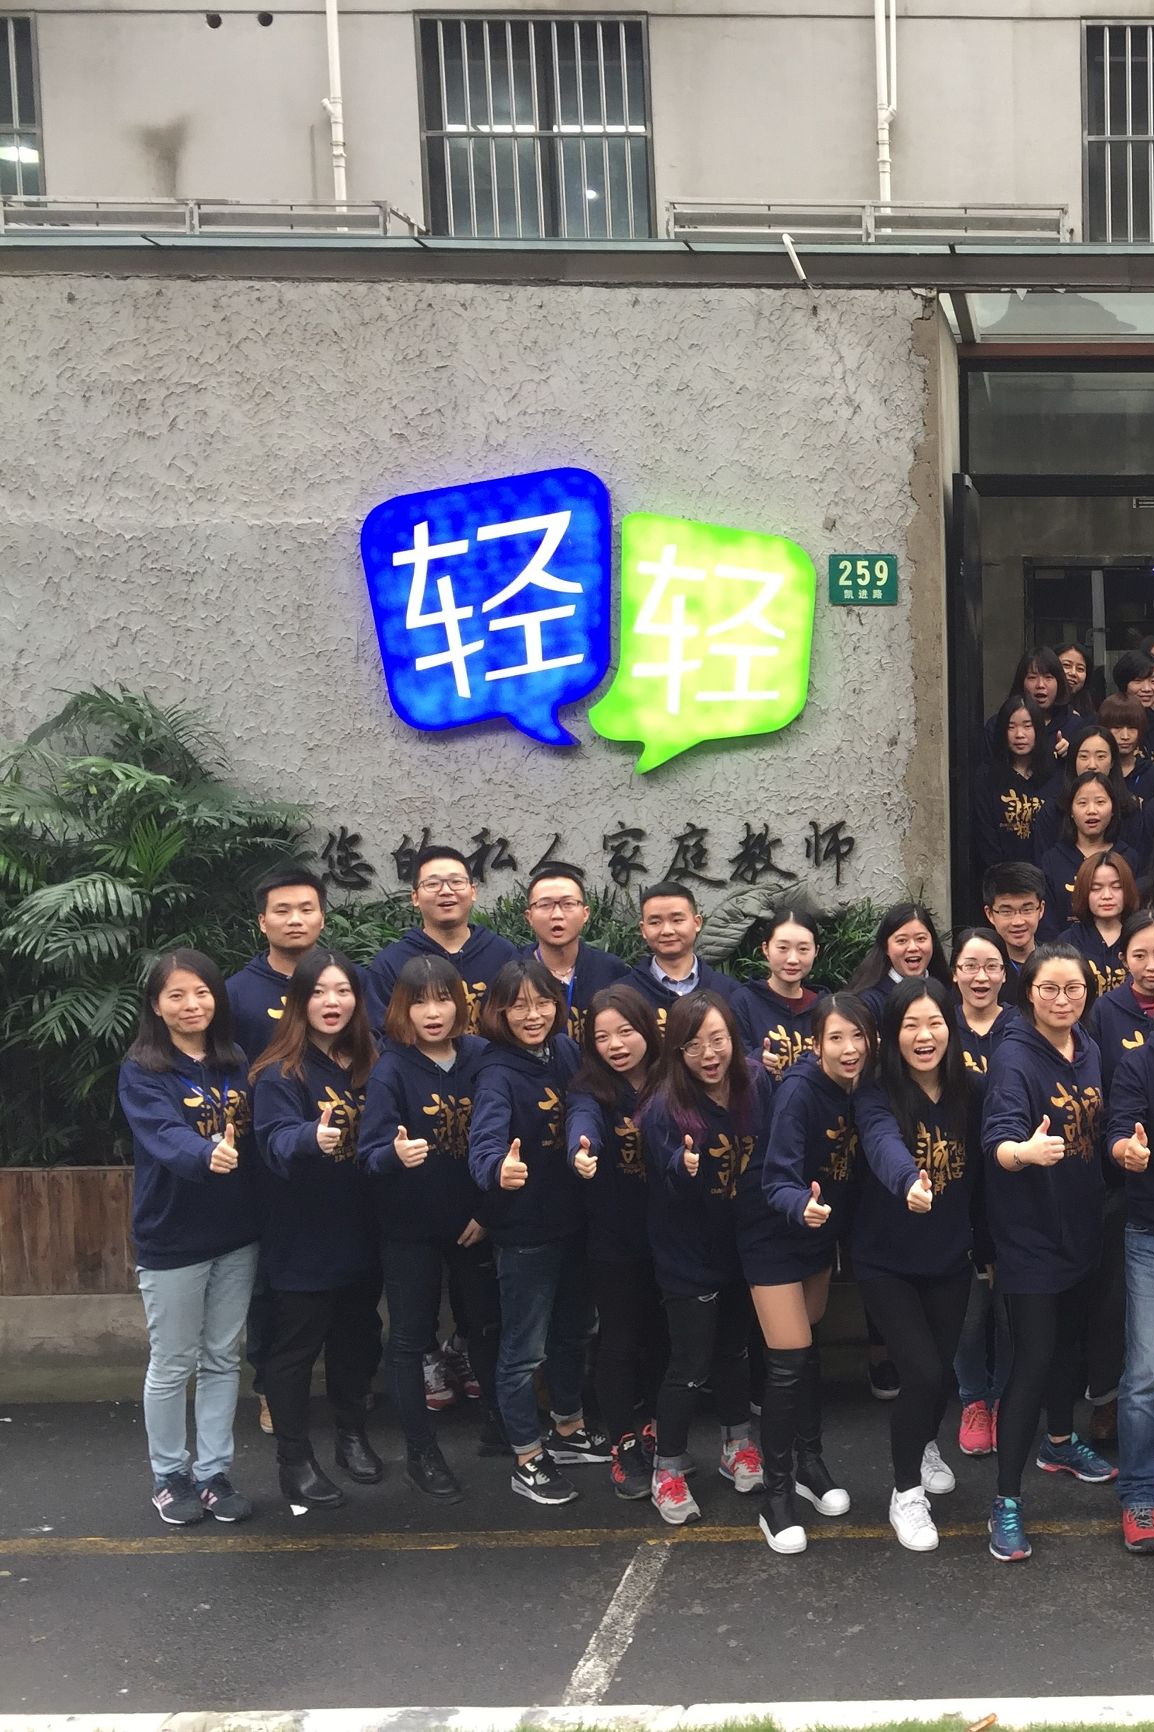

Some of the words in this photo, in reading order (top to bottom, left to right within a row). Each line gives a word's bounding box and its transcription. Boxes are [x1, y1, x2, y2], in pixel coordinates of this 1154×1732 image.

[838, 560, 889, 586] 259
[843, 589, 883, 599] 凯进路
